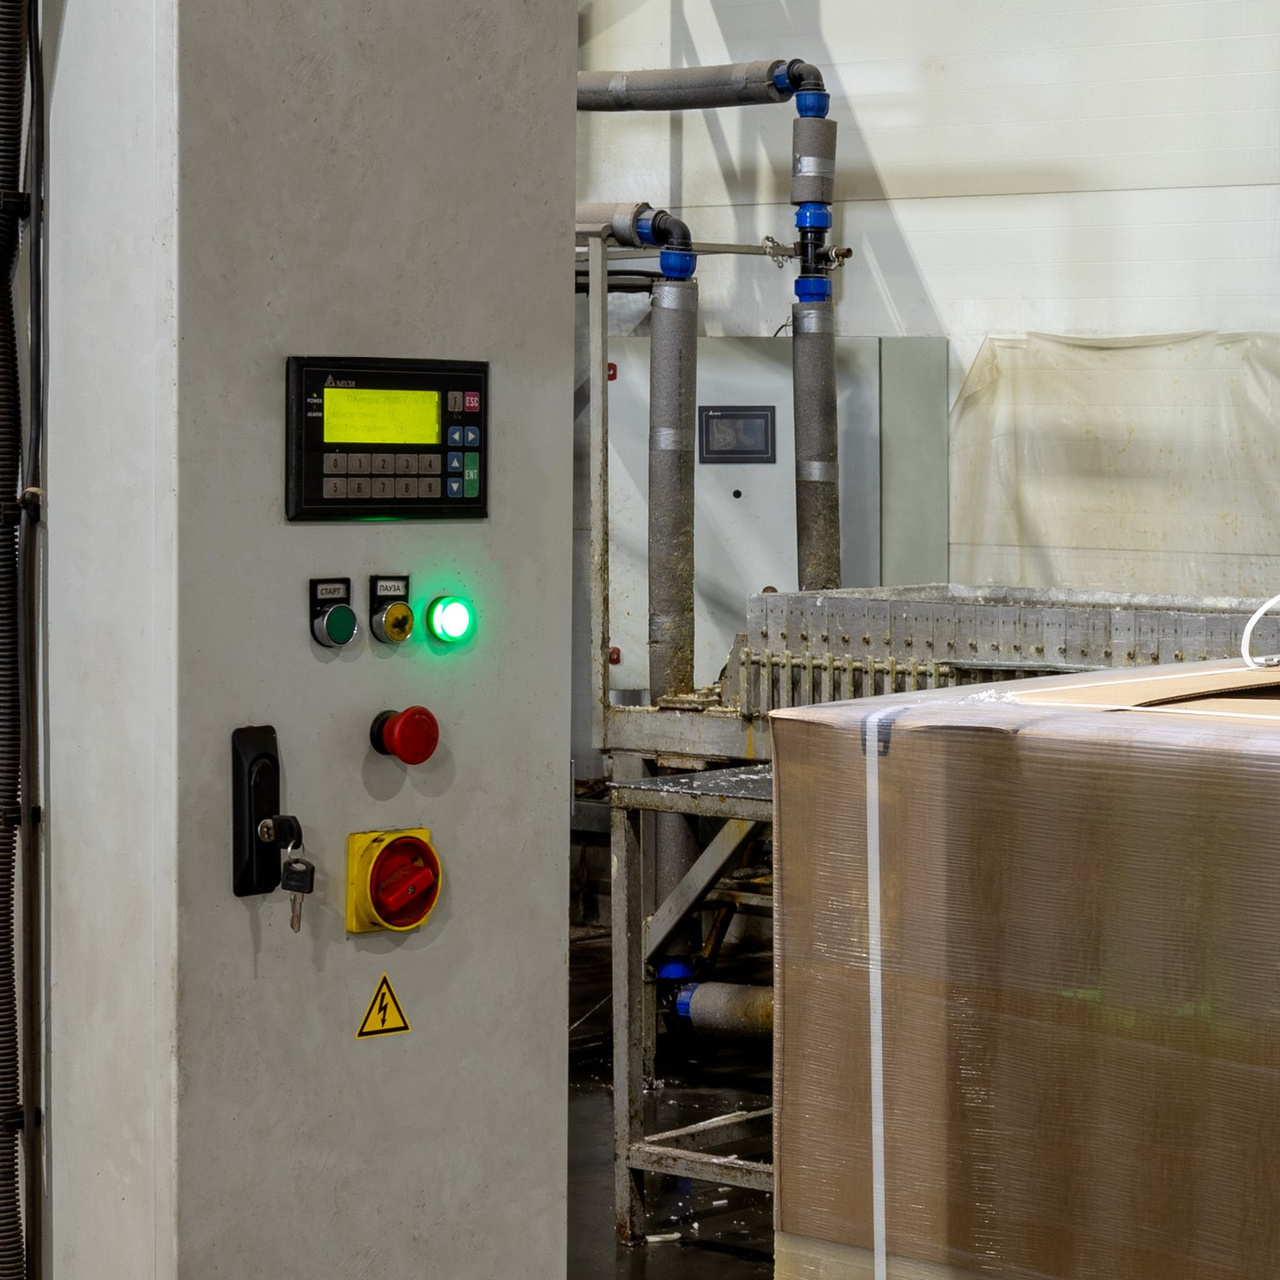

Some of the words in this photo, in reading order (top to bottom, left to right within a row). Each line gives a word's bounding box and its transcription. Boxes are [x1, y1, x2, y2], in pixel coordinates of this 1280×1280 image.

[466, 397, 479, 407] ESC
[333, 459, 338, 469] 0
[358, 459, 362, 469] 1
[381, 459, 386, 469] 2
[405, 459, 410, 469] 3
[427, 459, 432, 469] 4
[465, 470, 478, 480] ENT
[333, 483, 338, 493] 5
[357, 483, 362, 493] 6
[381, 483, 386, 493] 7
[405, 483, 410, 493] 8
[428, 483, 433, 493] 9
[320, 587, 341, 596] СТАРТ
[379, 584, 400, 592] ПАУЗА
